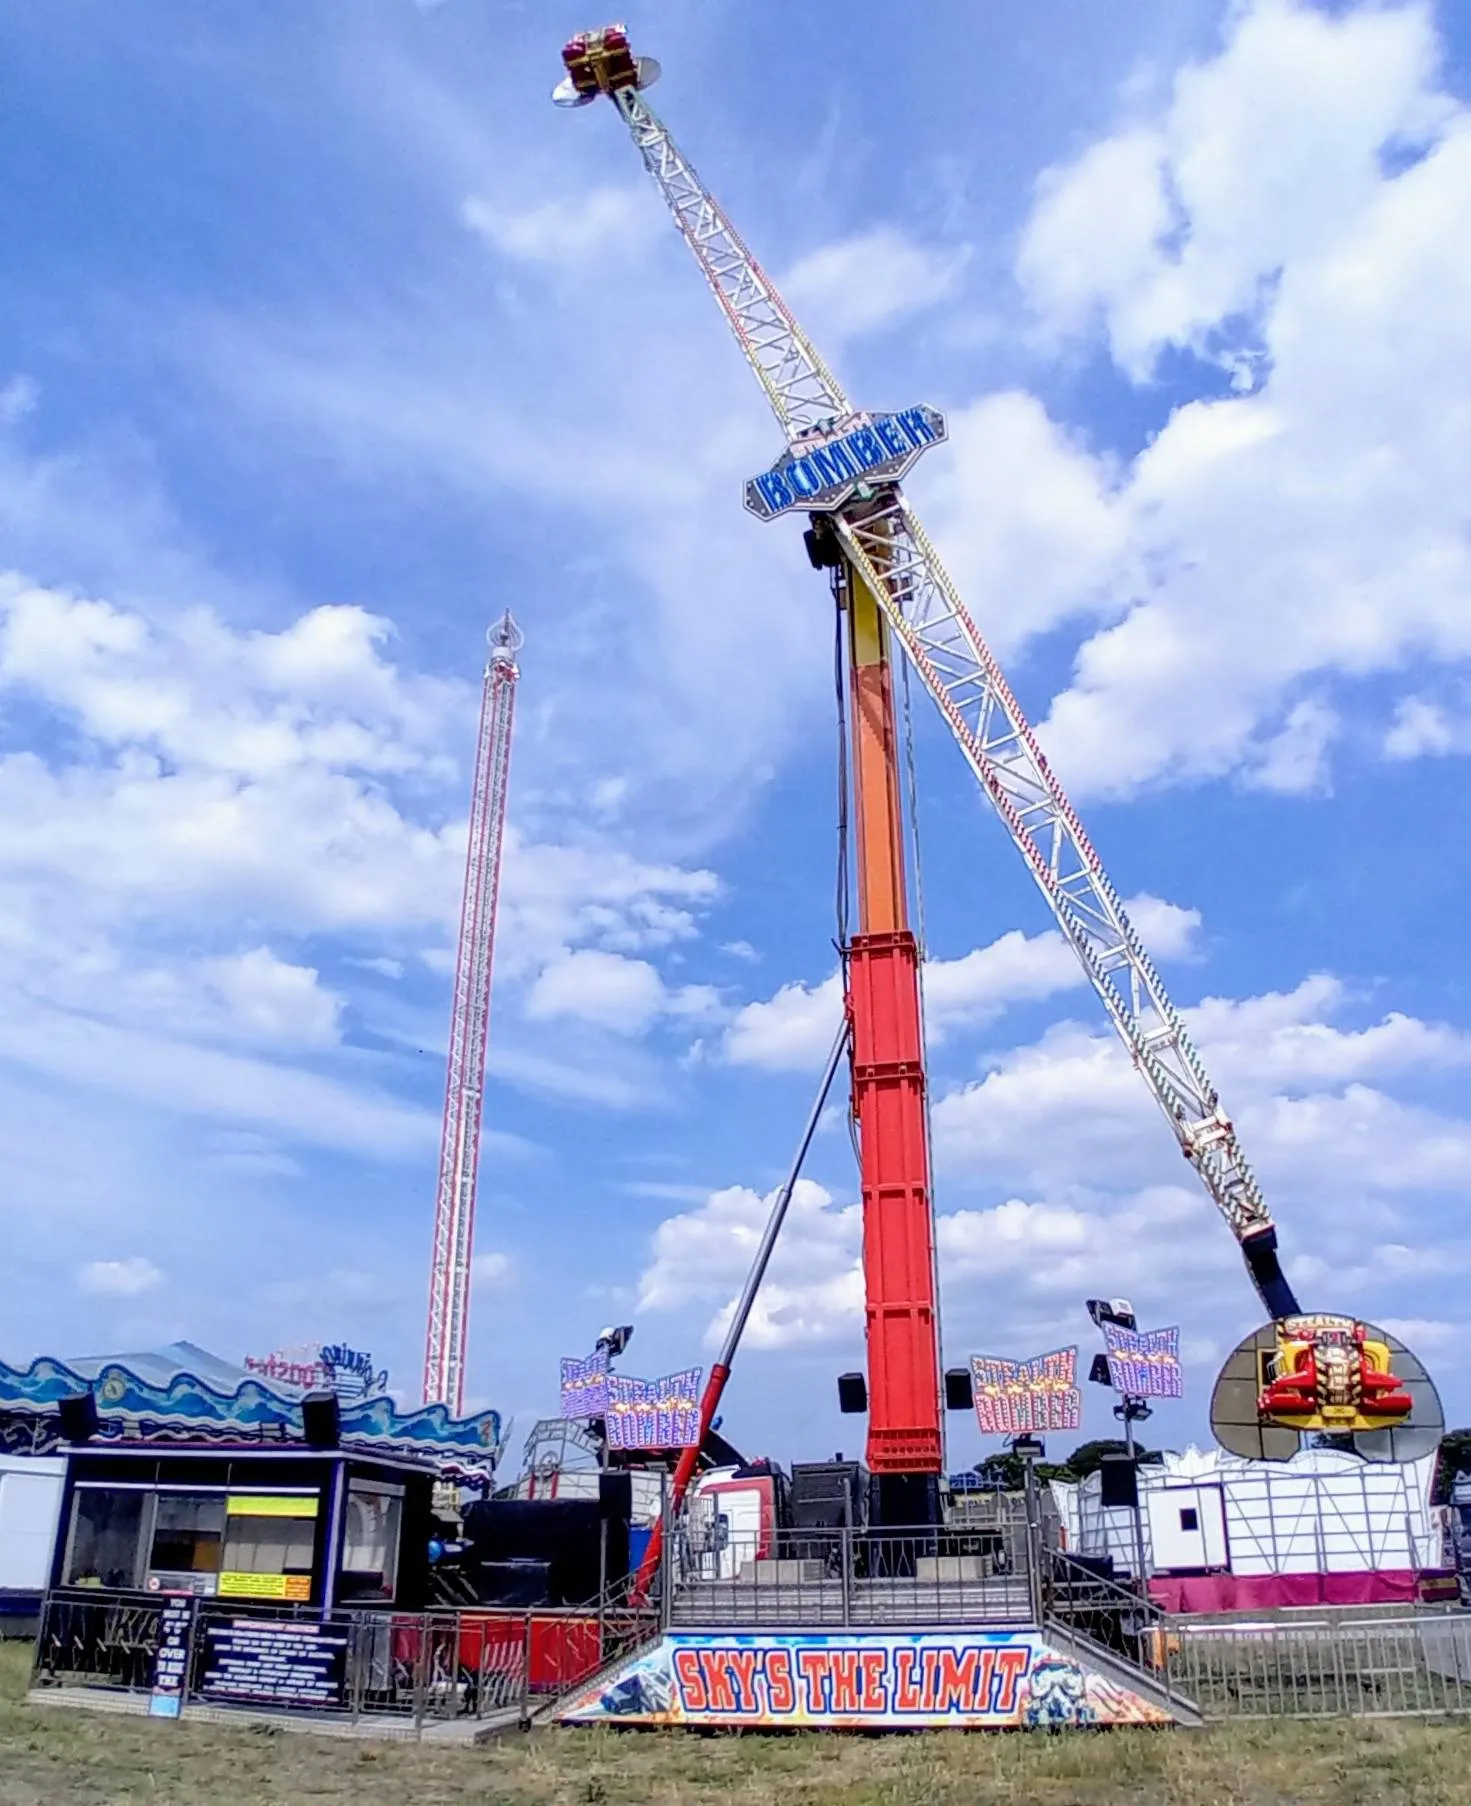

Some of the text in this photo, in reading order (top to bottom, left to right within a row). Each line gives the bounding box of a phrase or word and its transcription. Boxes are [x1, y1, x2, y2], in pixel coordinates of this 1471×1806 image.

[753, 408, 938, 514] BOMBER
[607, 1369, 700, 1404] STEALTH
[972, 1348, 1076, 1387] STEALTH
[1108, 1356, 1184, 1397] BOMBER
[606, 1408, 700, 1449] BOMBER
[975, 1387, 1080, 1433] BOMBER
[158, 1648, 186, 1660] OVER
[674, 1646, 1031, 1713] SKY'S THE LIMIT
